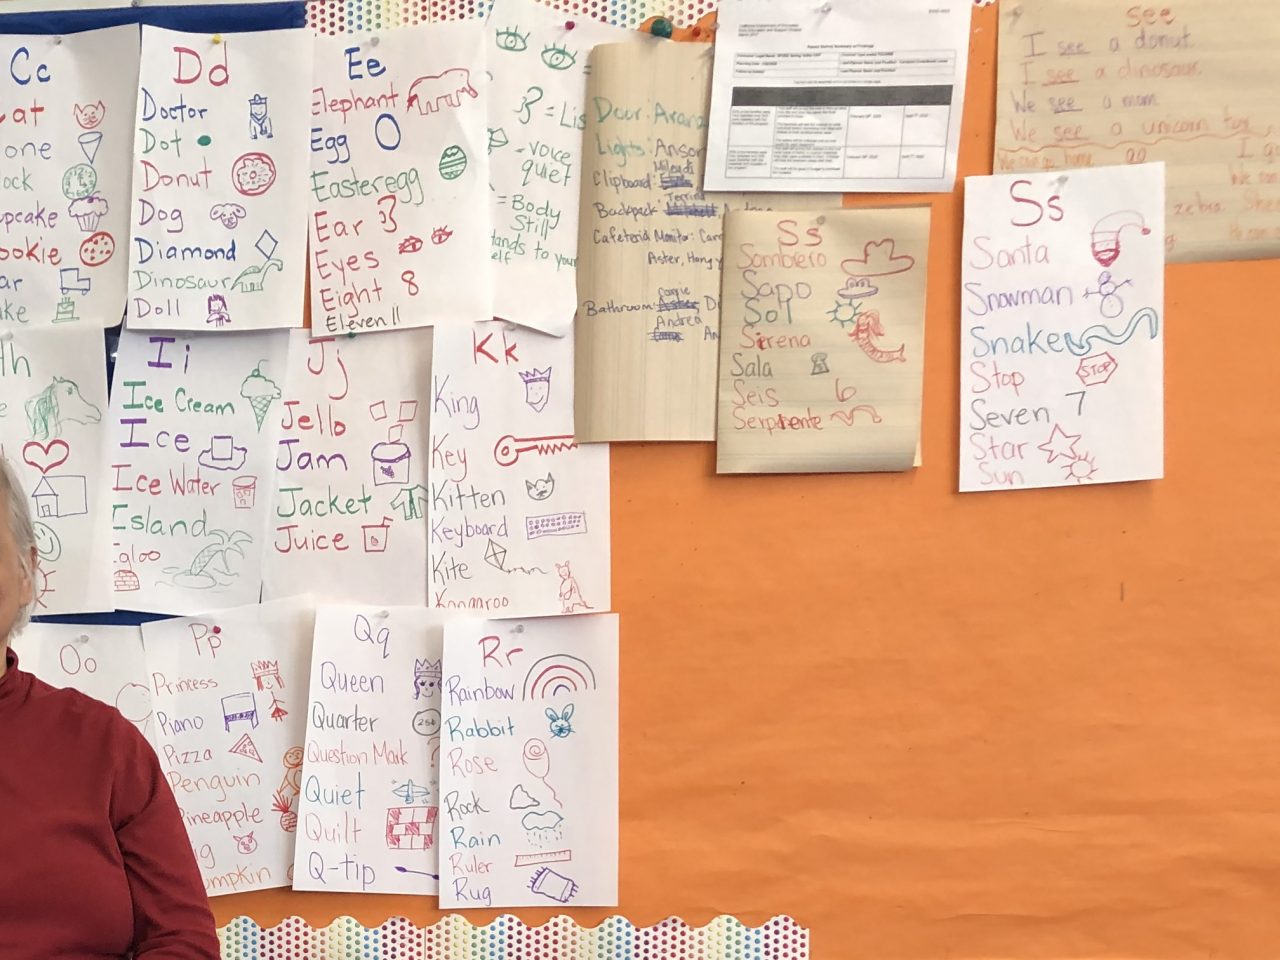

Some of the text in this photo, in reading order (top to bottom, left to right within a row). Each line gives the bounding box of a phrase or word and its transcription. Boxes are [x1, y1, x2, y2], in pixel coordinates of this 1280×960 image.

[142, 87, 208, 121] Doctor
[311, 83, 399, 124] Elephant
[142, 129, 182, 157] Dot
[311, 128, 350, 164] Egg
[140, 157, 213, 192] Donut
[139, 198, 183, 233] Dog
[314, 211, 363, 243] Ear
[511, 195, 561, 229] Body
[511, 214, 549, 241] Still
[134, 237, 236, 264] Diamond
[315, 250, 380, 279] Eyes
[970, 234, 1049, 270] Santa
[134, 270, 232, 290] Dinosaur
[320, 270, 419, 318] Eight 8
[740, 269, 811, 309] Sapo
[134, 298, 180, 318] Doll
[744, 298, 791, 325] Sol
[964, 282, 1073, 316] Snowman
[326, 312, 388, 333] Eleven
[971, 322, 1065, 358] Snake
[730, 352, 773, 378] Sala
[970, 361, 1112, 396] Stop STOP
[123, 381, 235, 416] Ice Cream
[435, 374, 480, 430] King
[732, 379, 779, 407] Seis
[281, 401, 346, 436] Jello
[970, 390, 1086, 431] Seven 7
[120, 418, 191, 451] Ice
[970, 433, 1029, 461] Star
[276, 439, 348, 471] Jam
[432, 433, 467, 482] Key
[111, 464, 223, 496] Ice Water
[979, 462, 1024, 485] Sun
[277, 484, 372, 517] Jacket
[432, 480, 506, 511] Kitten
[275, 525, 349, 553] Juice
[431, 515, 508, 548] Keyboard
[433, 551, 473, 585] Kite
[152, 672, 218, 697] Princess
[320, 661, 385, 694] Queen
[445, 675, 515, 706] Rainbow
[157, 711, 204, 736] Piano
[312, 701, 378, 733] Quarter
[445, 716, 514, 739] Rabbit
[164, 744, 213, 767] Pizza
[308, 739, 408, 765] Question Mark
[448, 748, 498, 777] Rose
[168, 771, 261, 802] Penguin
[305, 771, 366, 810] Quiet
[445, 791, 490, 820] Rock
[305, 812, 362, 845] Quilt
[451, 826, 501, 849] Rain
[309, 852, 376, 891] Q-tip
[449, 852, 494, 876] Ruler
[453, 877, 492, 906] Rug
